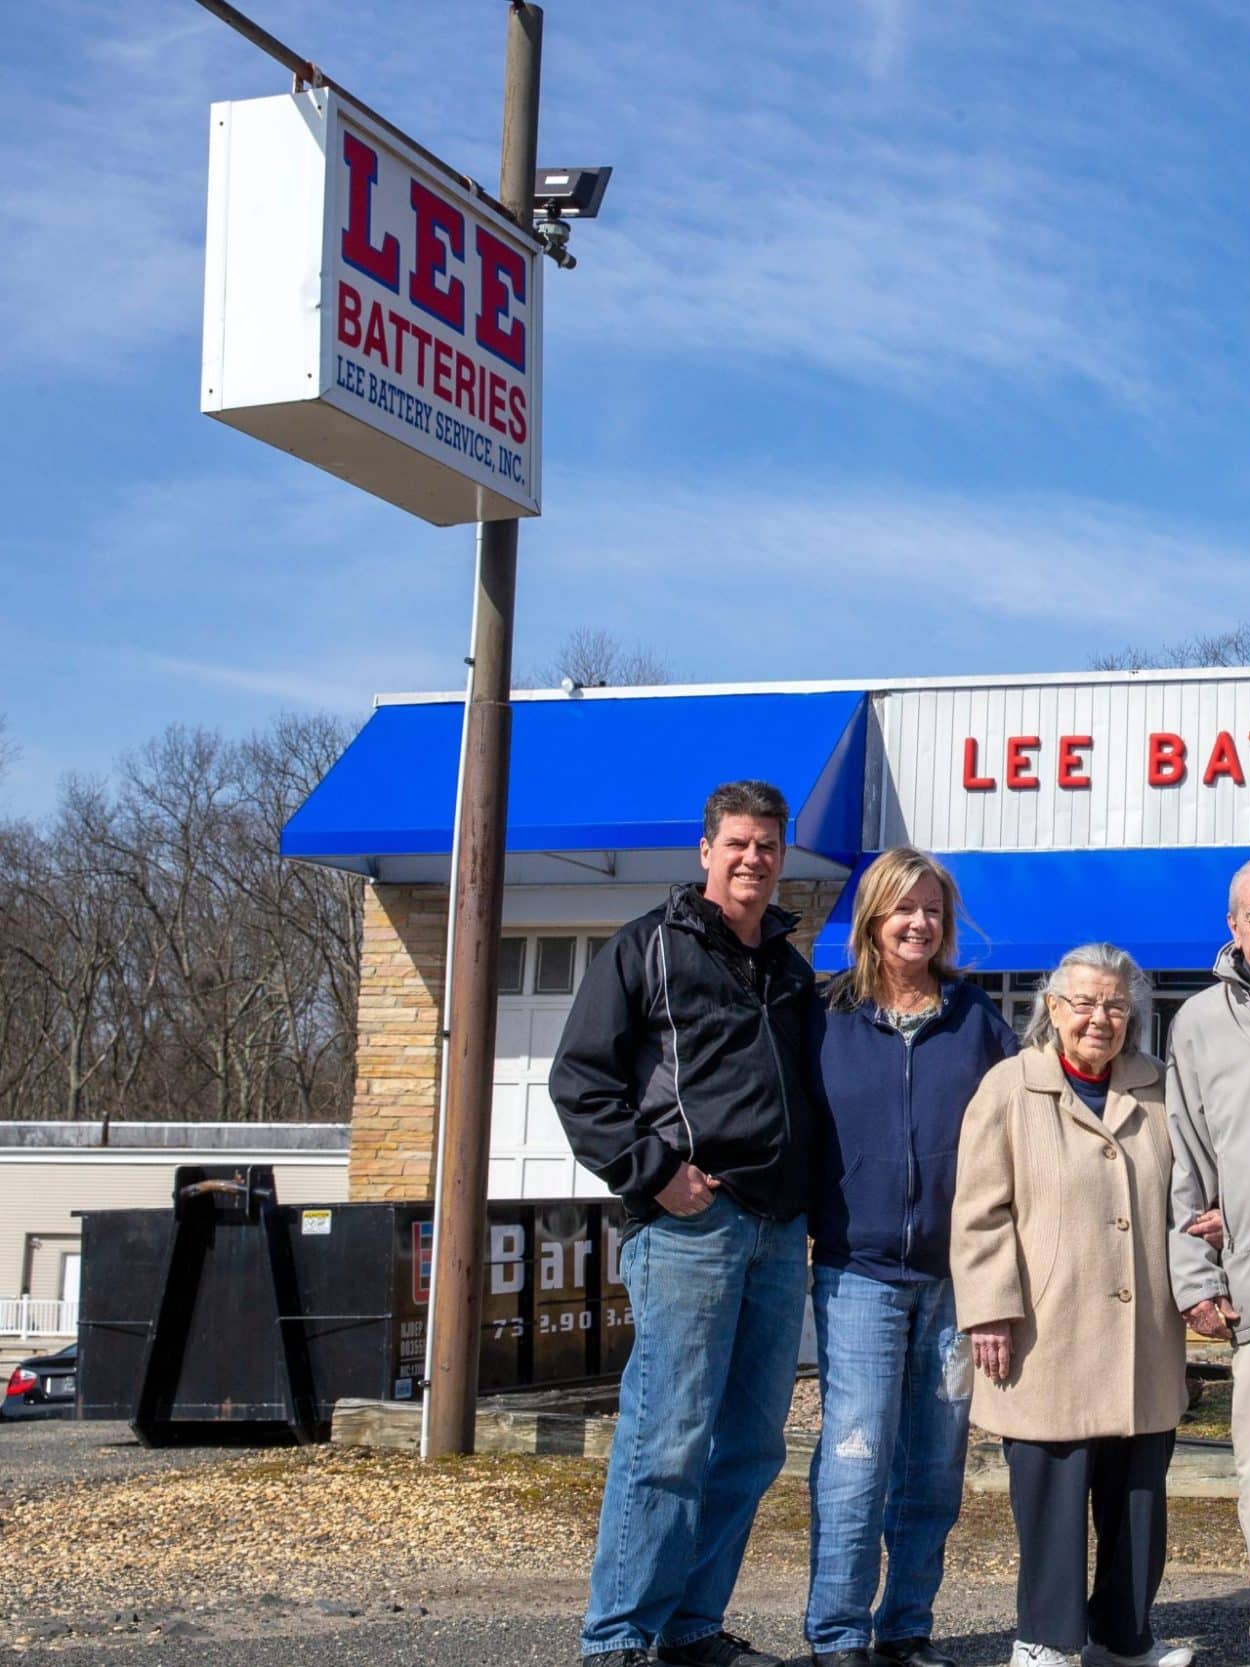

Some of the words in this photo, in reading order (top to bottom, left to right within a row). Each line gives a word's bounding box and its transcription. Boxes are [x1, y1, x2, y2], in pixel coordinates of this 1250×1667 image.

[341, 129, 526, 375] LEE
[337, 280, 527, 444] BATTERIES
[337, 354, 366, 399] LEE
[368, 372, 433, 435] BATTERY
[435, 410, 496, 474] SERVICE,
[498, 444, 526, 486] INC.
[963, 735, 1093, 791] LEE
